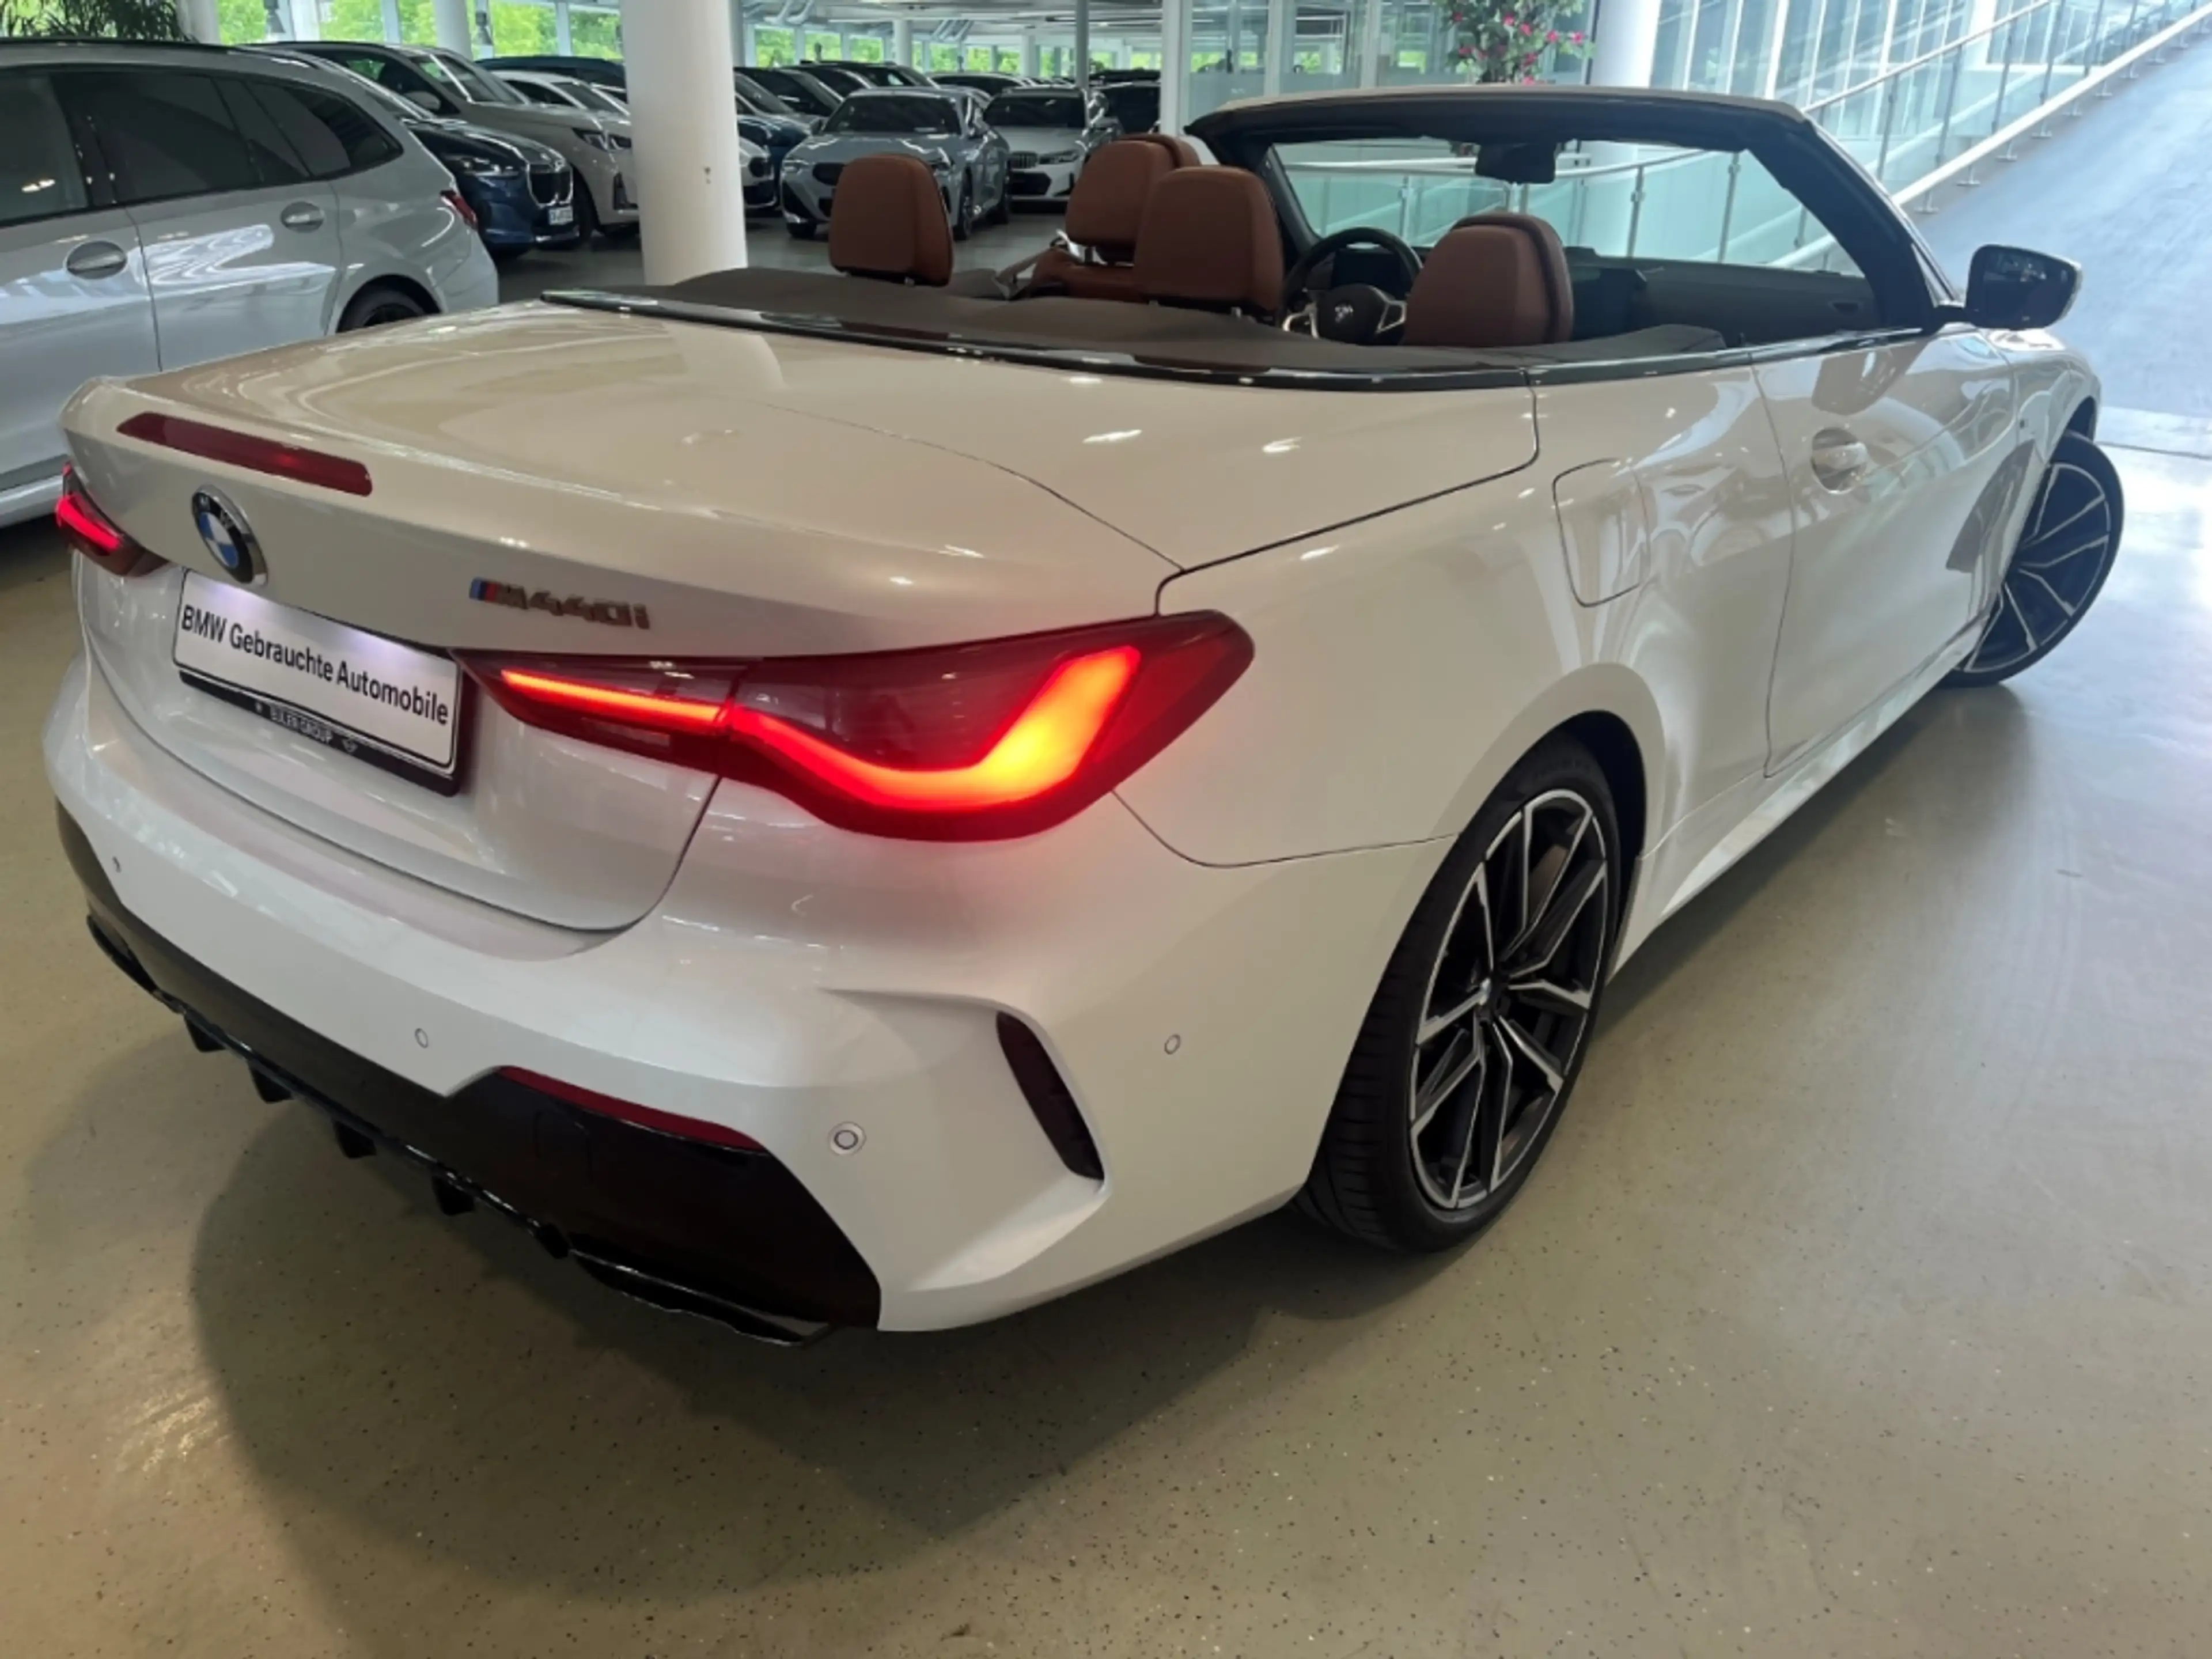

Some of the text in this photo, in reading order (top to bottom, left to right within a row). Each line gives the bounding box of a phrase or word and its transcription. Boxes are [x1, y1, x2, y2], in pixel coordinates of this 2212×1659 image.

[483, 578, 650, 630] M440i
[182, 605, 448, 725] BMW Gebrauchte Automobile
